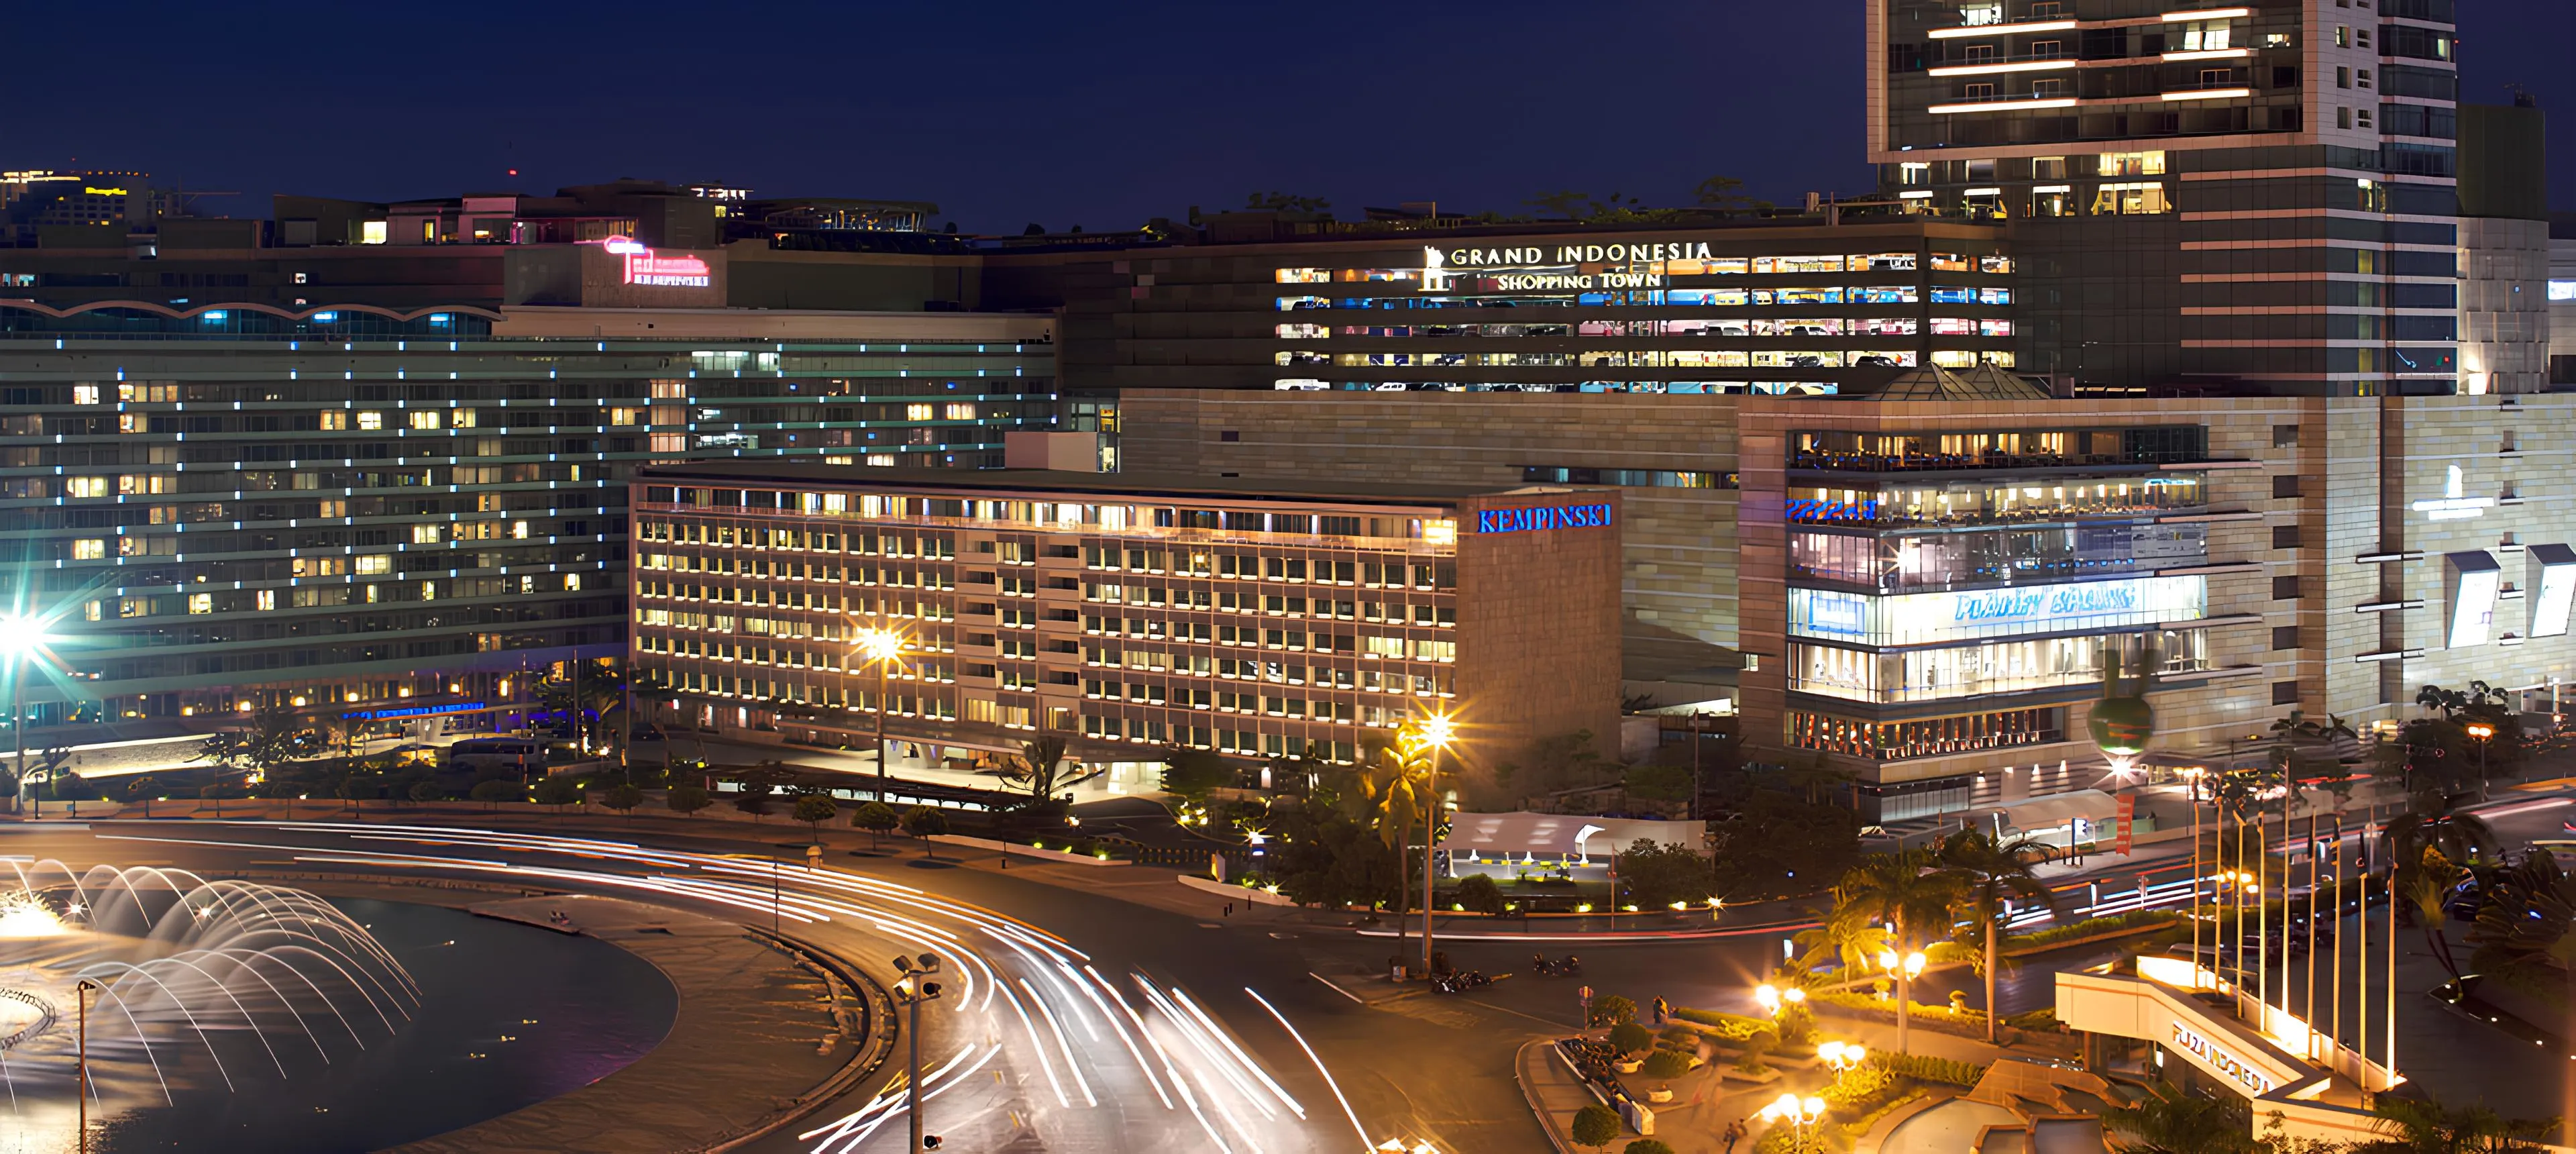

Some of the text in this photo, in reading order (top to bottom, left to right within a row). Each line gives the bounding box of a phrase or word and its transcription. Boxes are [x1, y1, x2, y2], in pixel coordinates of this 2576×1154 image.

[1451, 242, 1712, 265] GRAND INDONESIA
[1498, 272, 1660, 291] SHOPPING TOWN
[1478, 504, 1611, 533] KEMPINSKI
